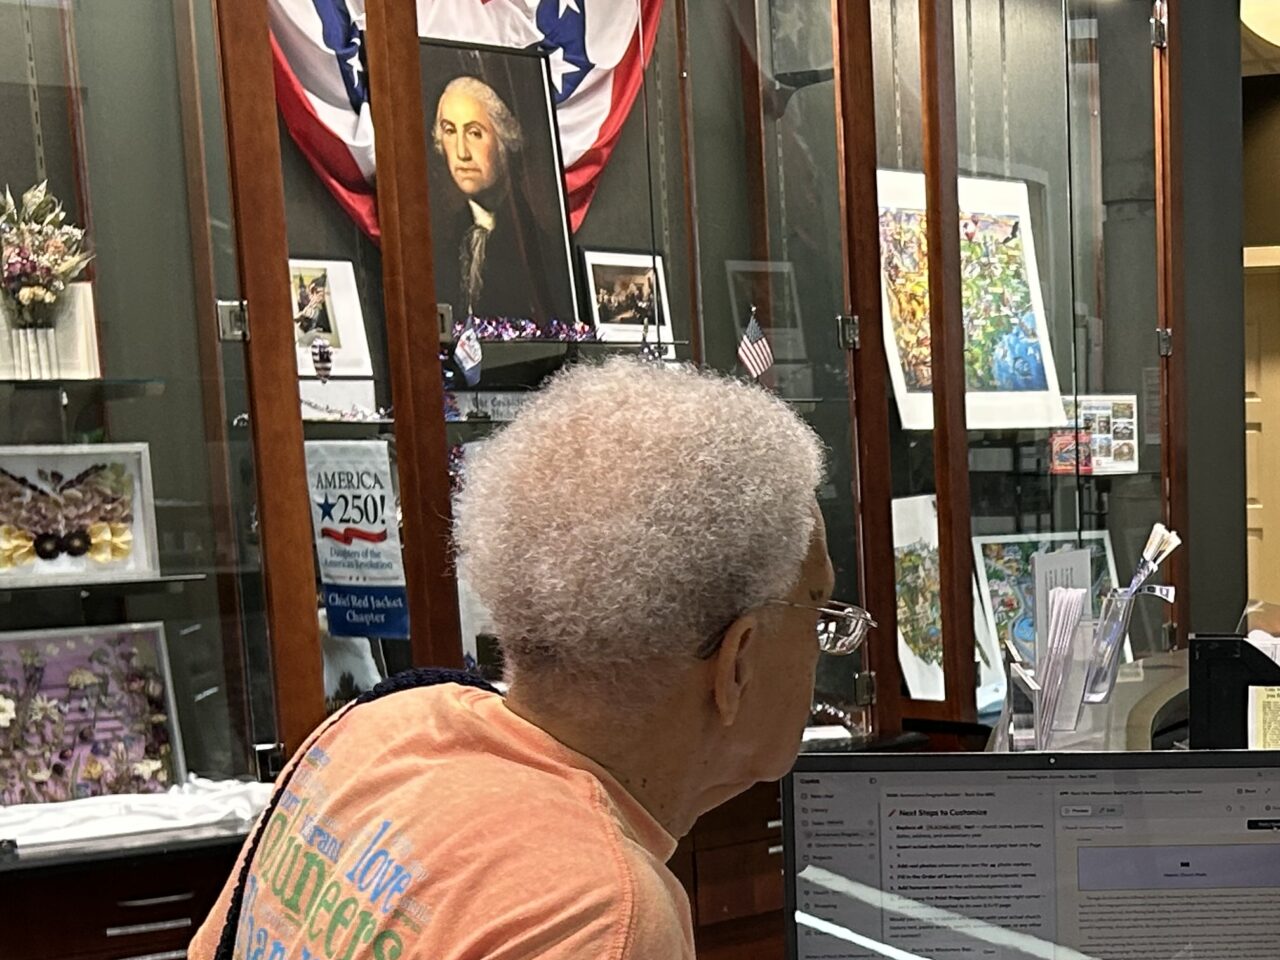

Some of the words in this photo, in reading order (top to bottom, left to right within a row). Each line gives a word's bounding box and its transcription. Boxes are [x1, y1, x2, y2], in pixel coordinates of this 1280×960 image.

[316, 471, 384, 490] AMERICA
[338, 494, 386, 525] 250!
[329, 547, 360, 560] Daughters
[361, 547, 369, 558] of
[370, 547, 382, 558] the
[328, 592, 350, 607] Chief
[351, 594, 369, 608] Red
[370, 594, 404, 610] Jacket
[346, 609, 386, 626] Chapter
[899, 809, 917, 817] Next
[918, 808, 939, 818] Steps
[949, 808, 988, 816] Customize
[346, 819, 412, 913] love
